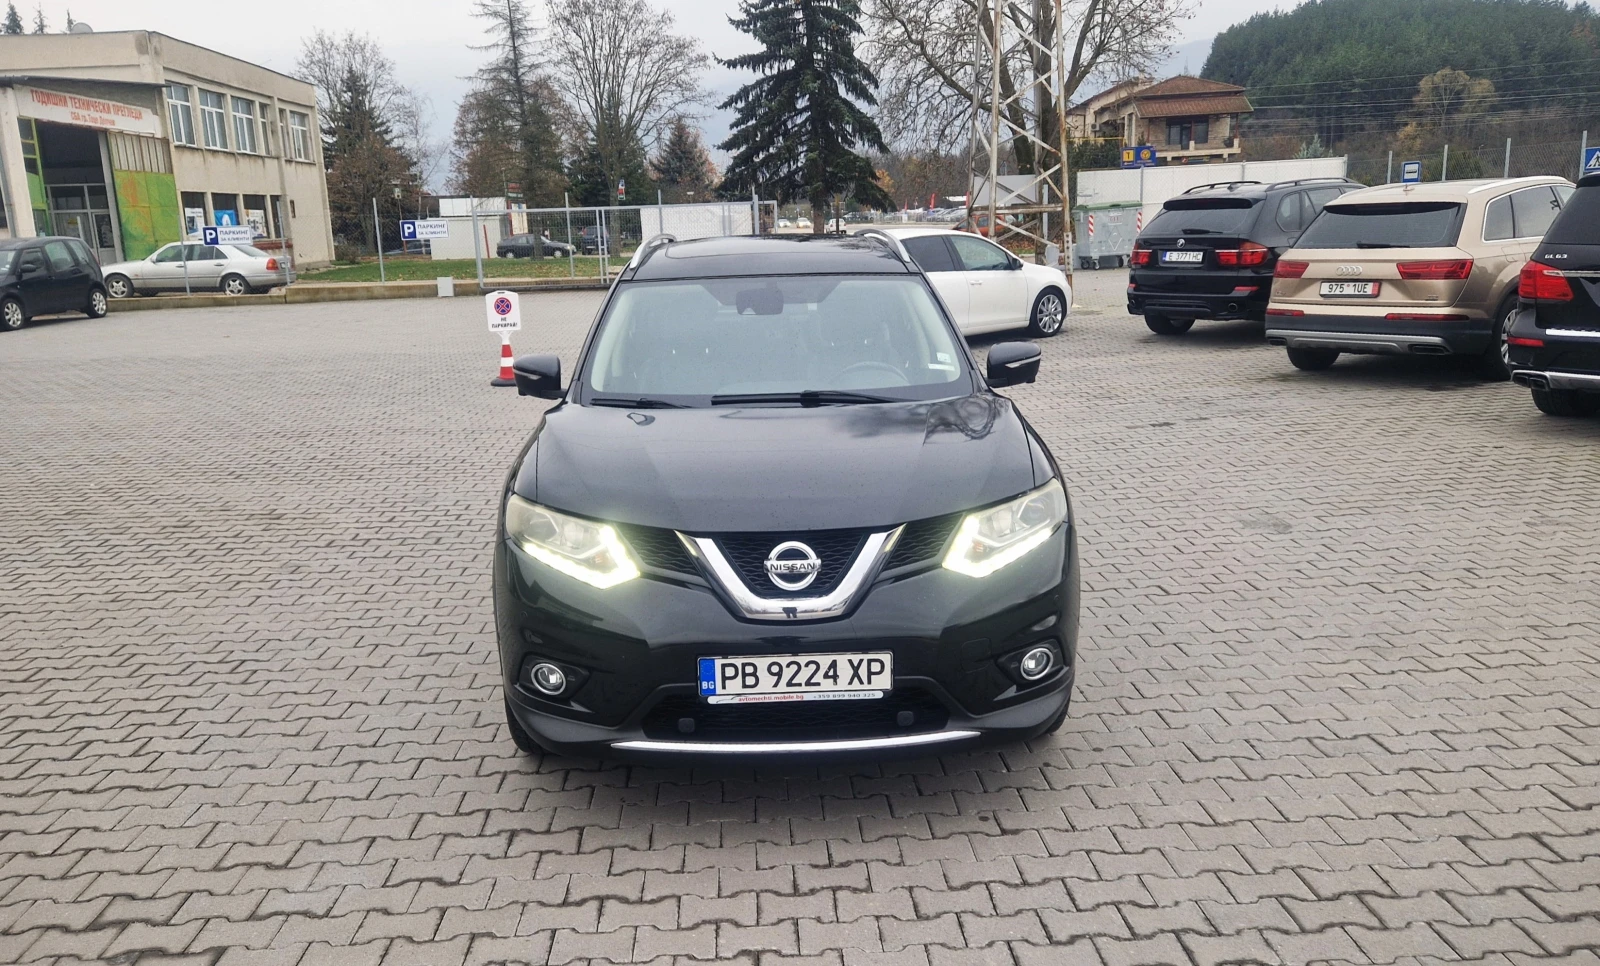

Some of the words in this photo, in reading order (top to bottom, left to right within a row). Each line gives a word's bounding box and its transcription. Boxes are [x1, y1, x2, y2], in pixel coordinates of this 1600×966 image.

[30, 89, 68, 107] ГОДИШНИ
[69, 96, 111, 114] ТЕХНИЧЕСКИ
[112, 103, 143, 121] ПРЕГЛЕДИ
[1328, 283, 1345, 293] 975
[1352, 283, 1369, 293] 1UE
[770, 563, 815, 571] NISSAN
[720, 662, 760, 690] PB
[766, 659, 839, 688] 9224
[847, 658, 885, 686] XP
[702, 681, 714, 690] BG
[738, 694, 804, 702] avtomechti.mobile.bg
